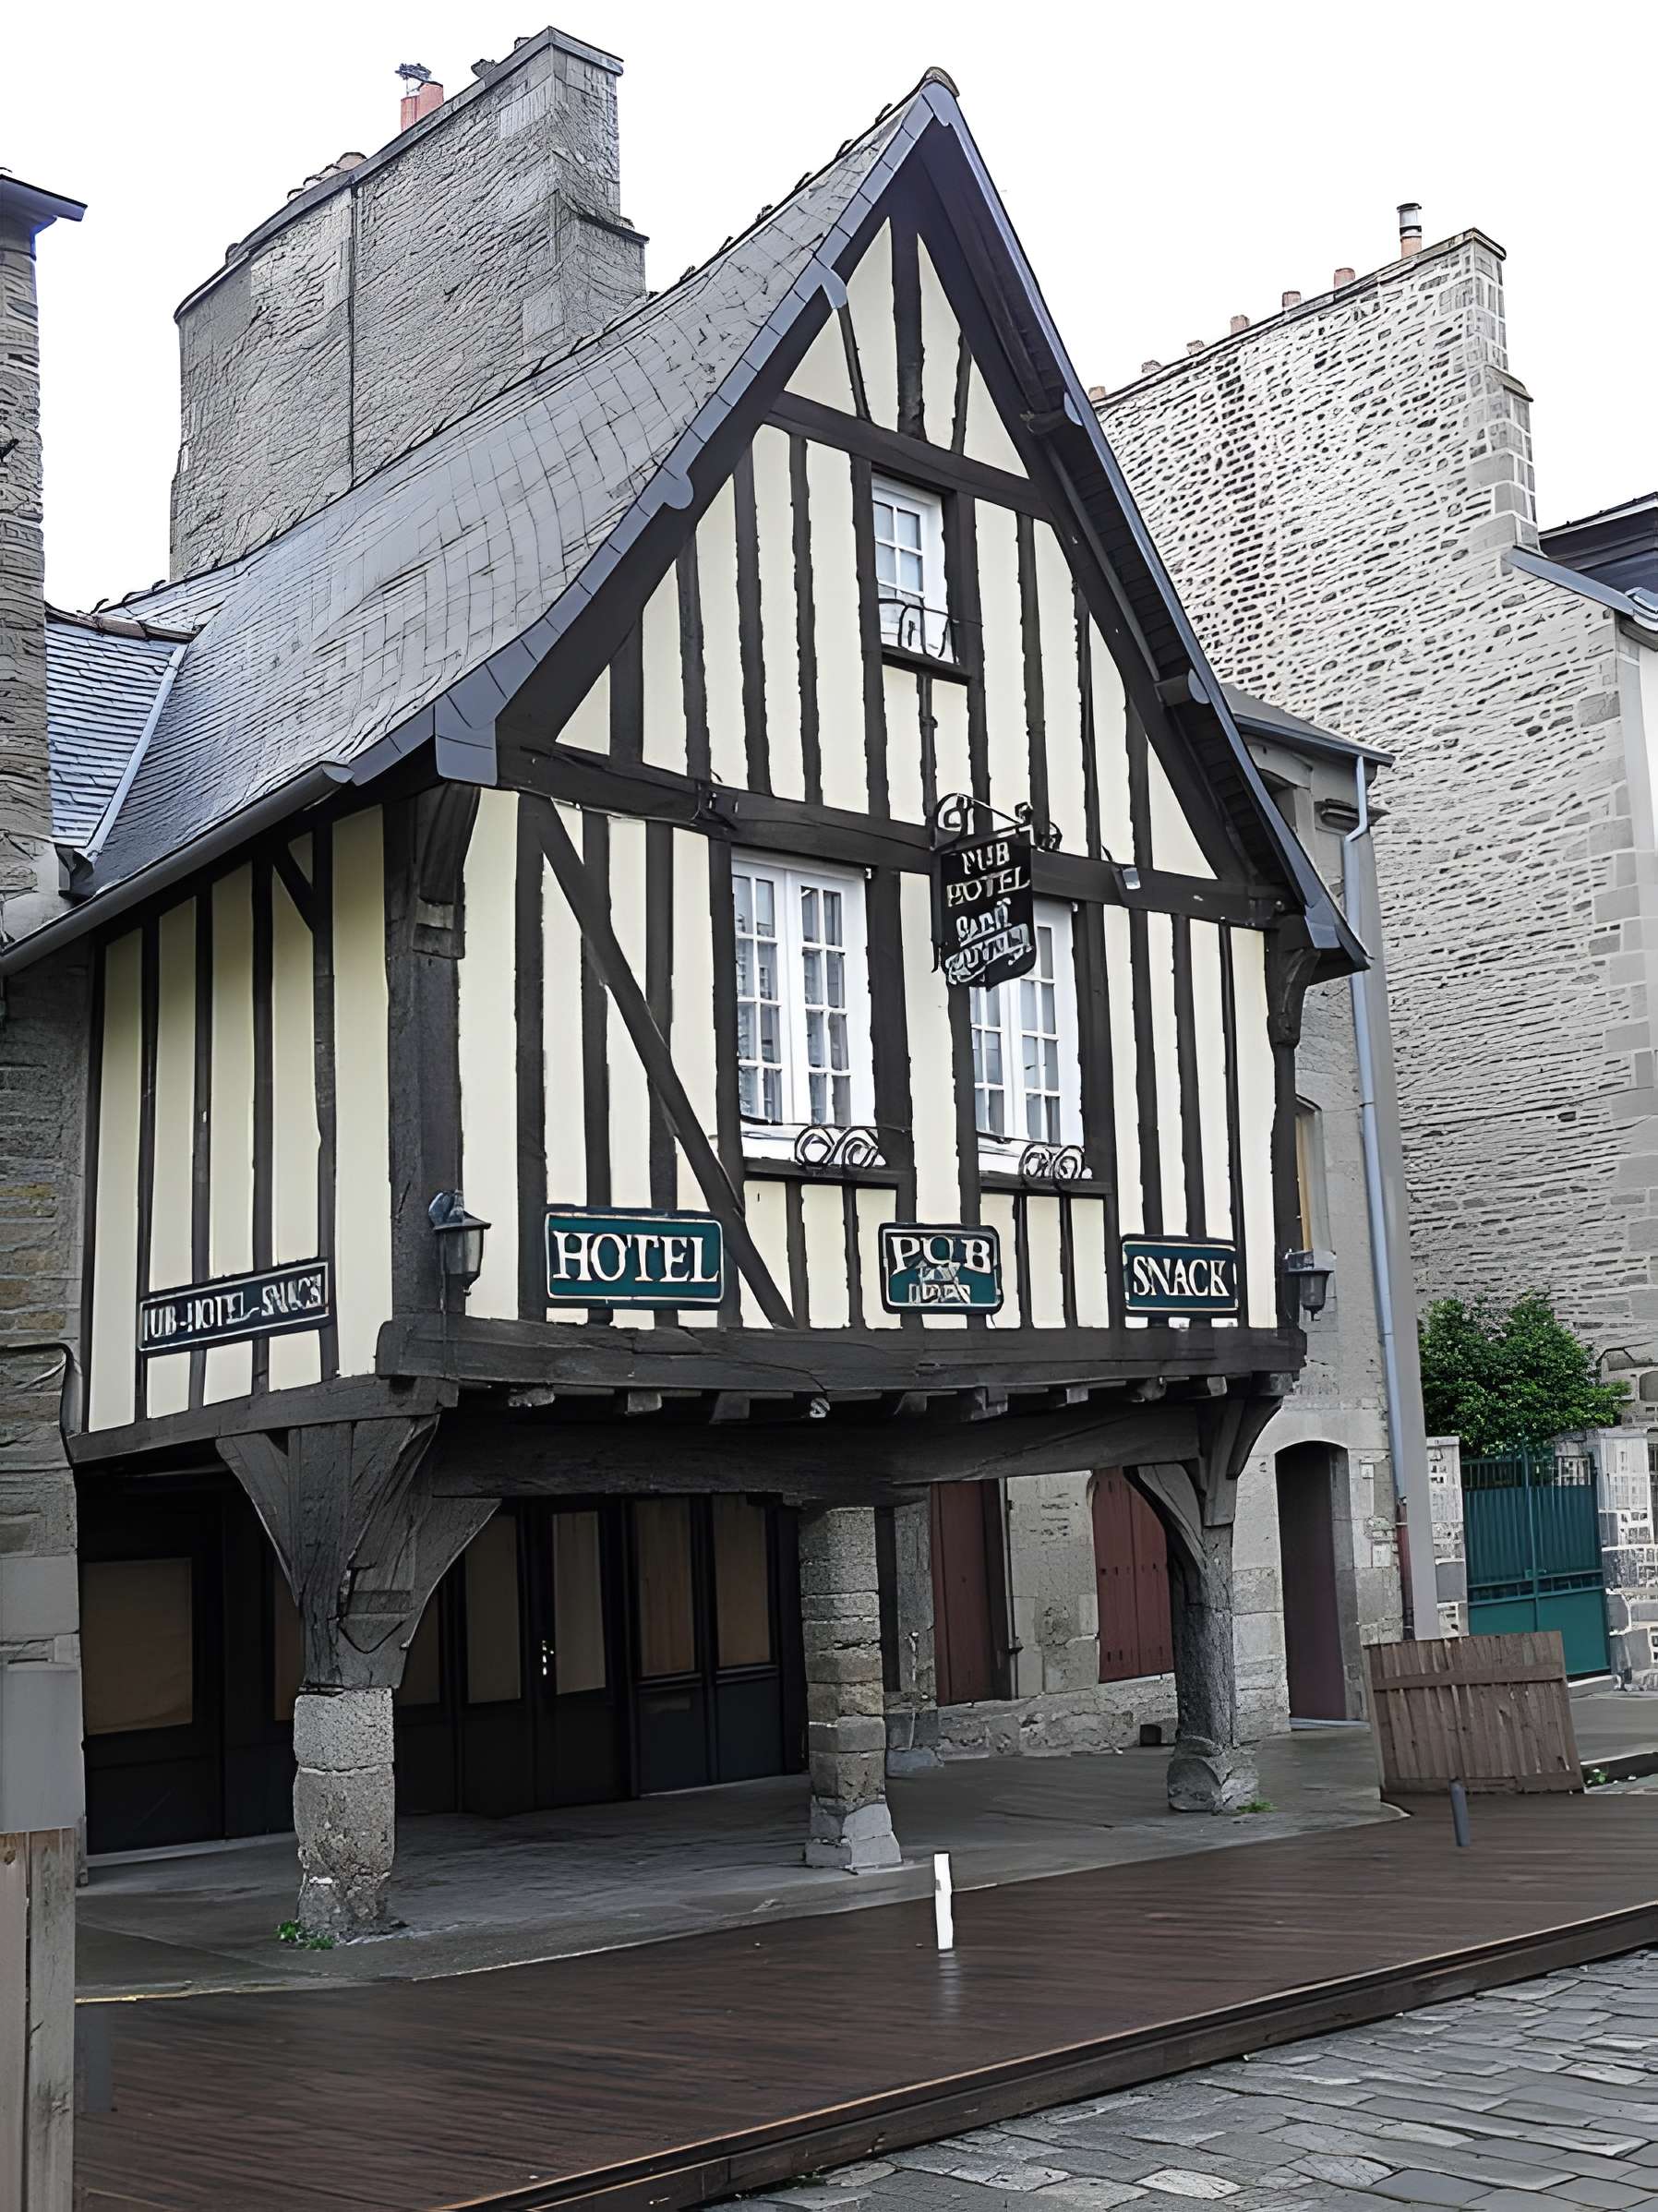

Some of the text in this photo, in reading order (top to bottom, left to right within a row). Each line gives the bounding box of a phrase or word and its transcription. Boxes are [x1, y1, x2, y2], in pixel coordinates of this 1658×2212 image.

[961, 841, 1010, 874] PUB
[946, 866, 1030, 907] HOTEL
[552, 1231, 719, 1282] HOTEL
[890, 1235, 991, 1274] PUB
[1133, 1256, 1230, 1297] SNACK
